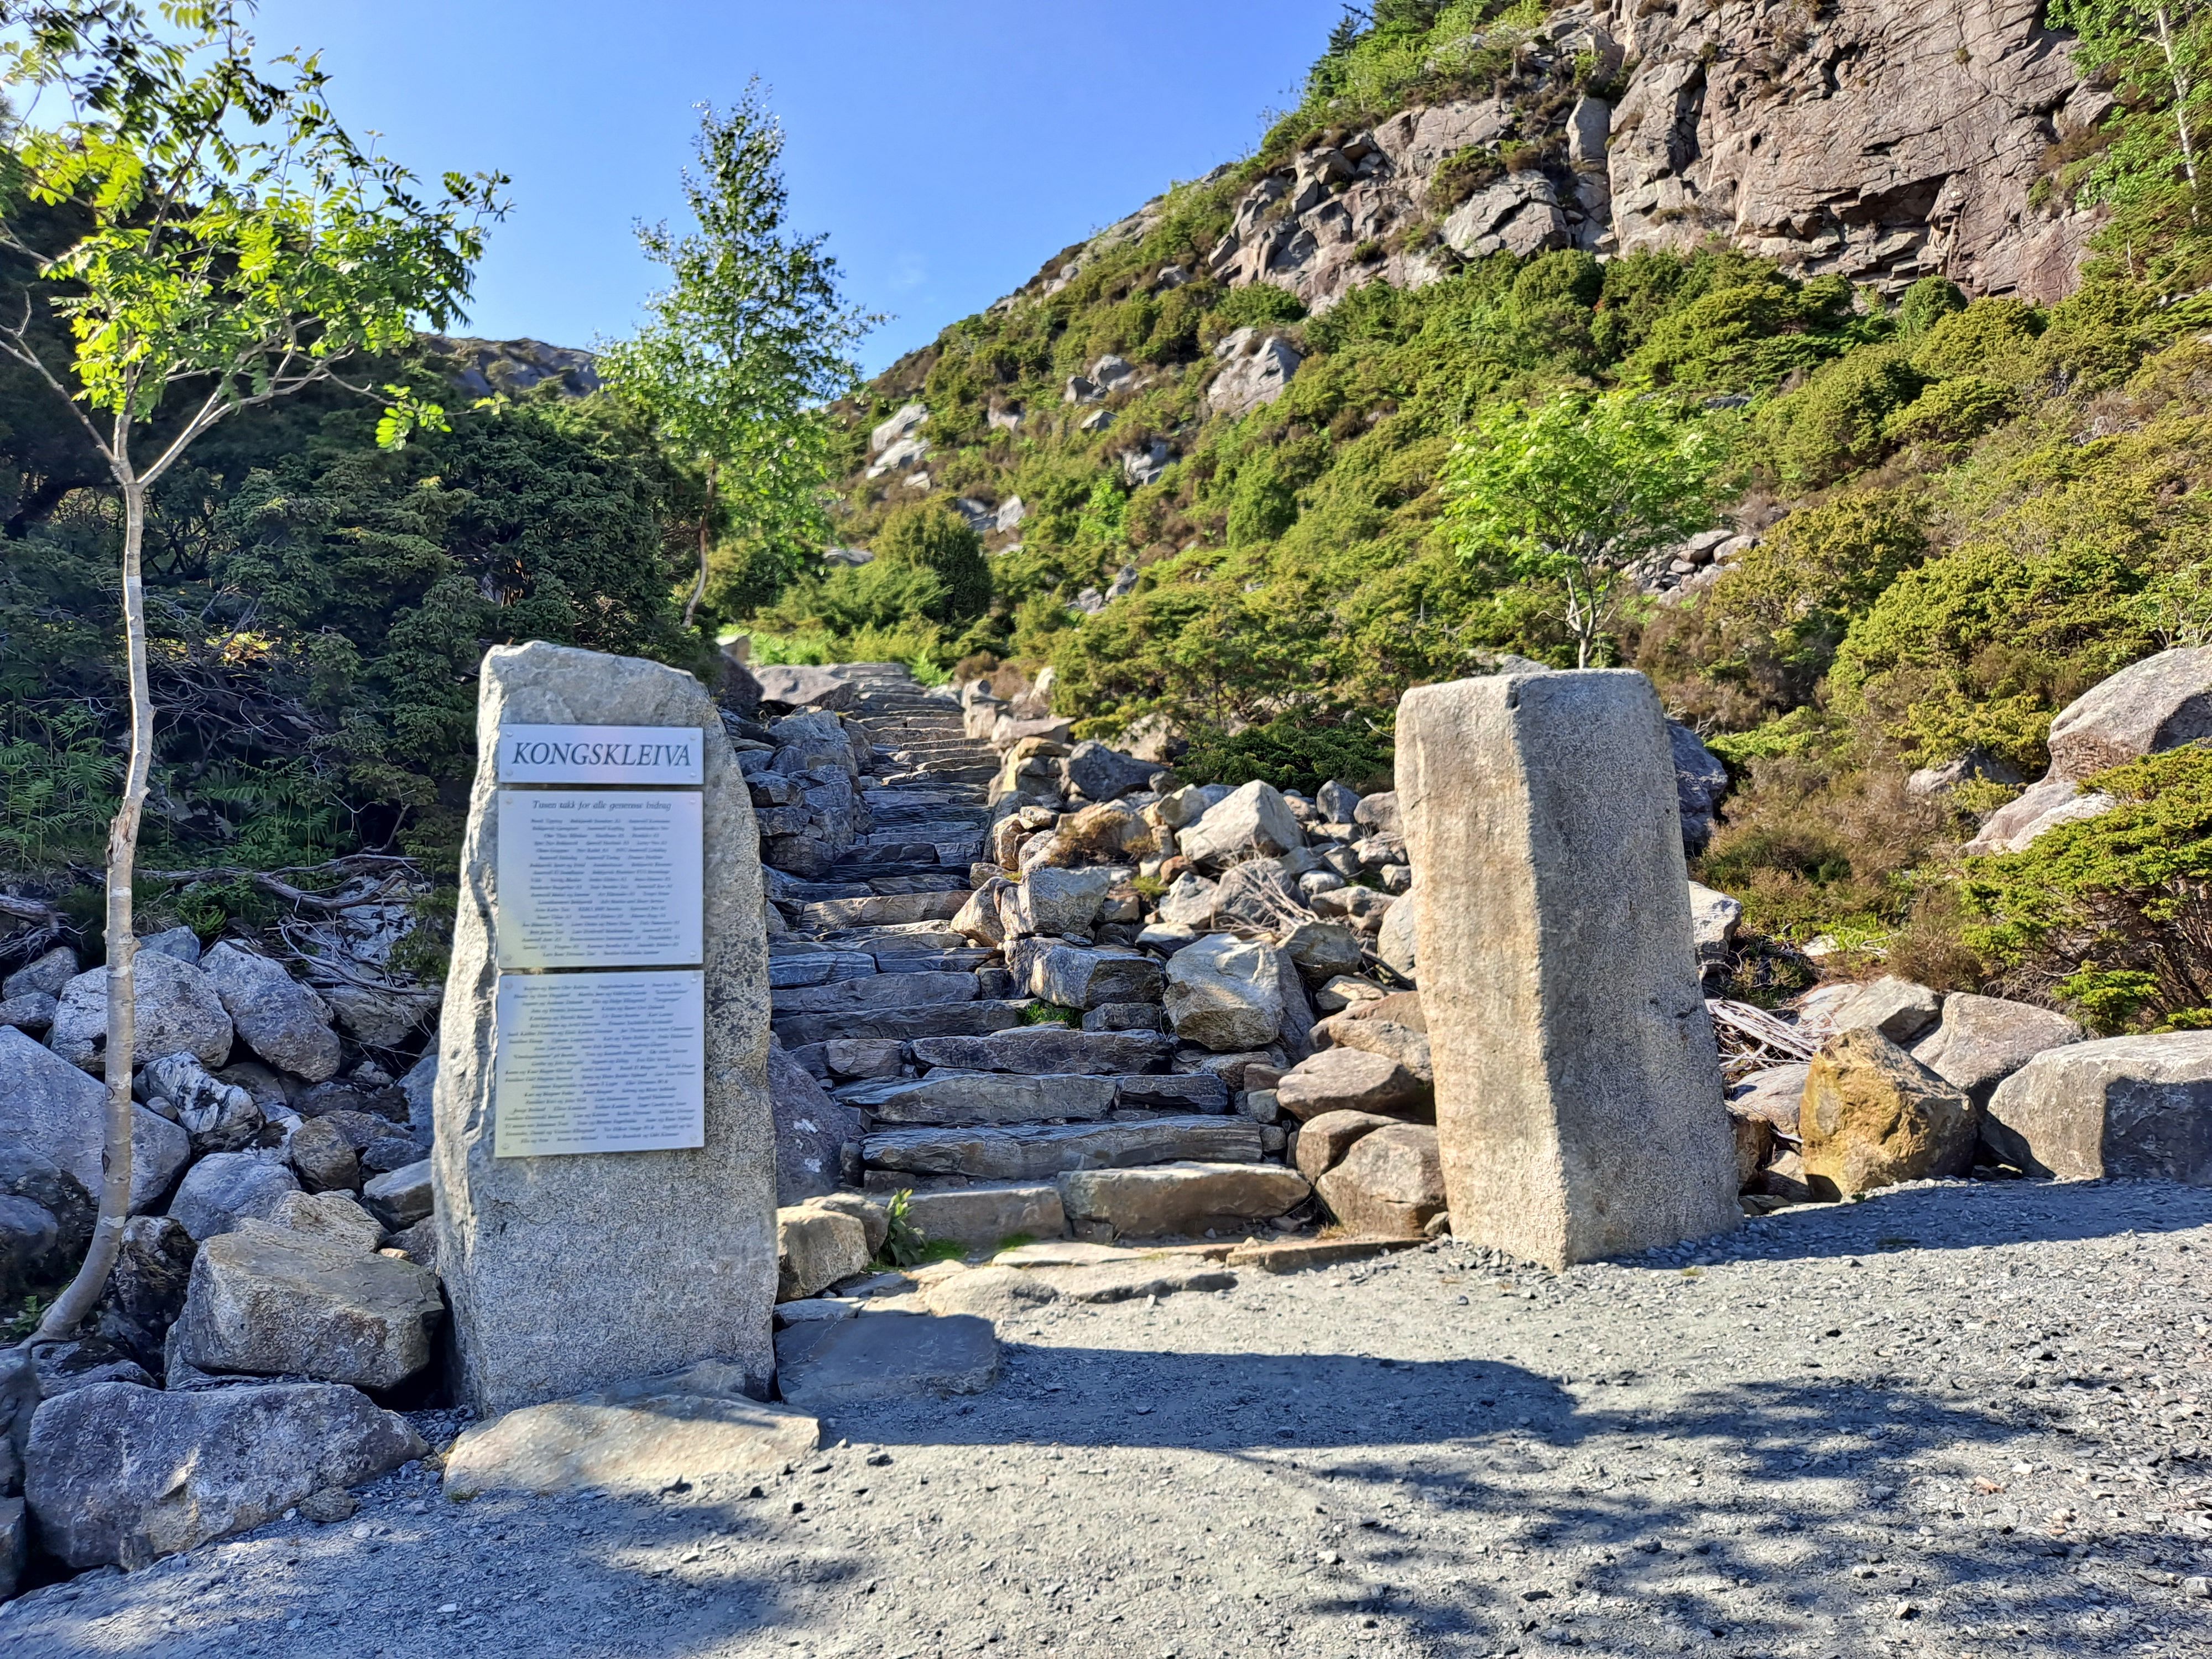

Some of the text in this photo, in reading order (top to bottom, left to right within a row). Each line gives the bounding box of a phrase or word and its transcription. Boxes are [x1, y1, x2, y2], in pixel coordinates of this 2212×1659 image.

[512, 743, 691, 766] KONGSKLEIVA
[533, 800, 557, 808] Tusen
[560, 800, 575, 808] takk
[577, 800, 590, 810] for
[593, 800, 606, 808] alle
[646, 800, 671, 811] bidrag
